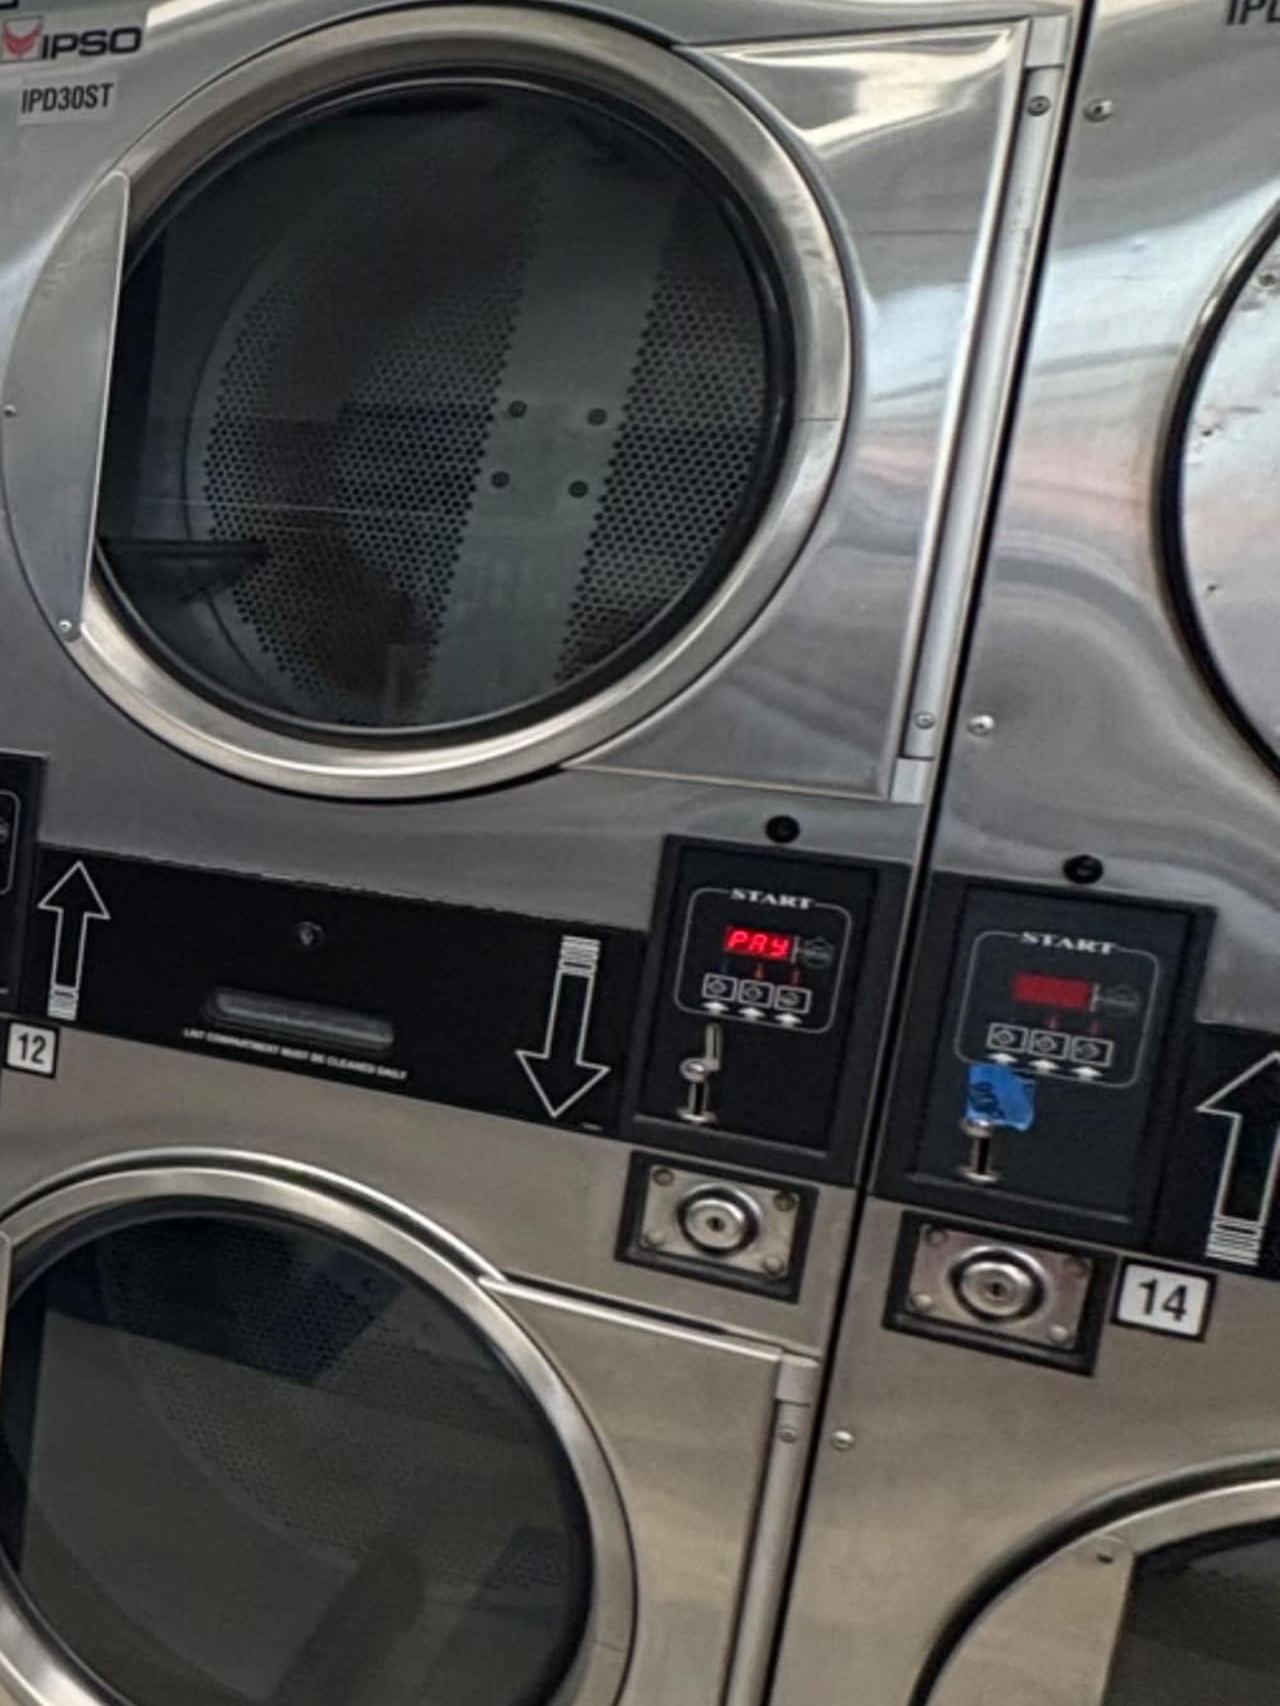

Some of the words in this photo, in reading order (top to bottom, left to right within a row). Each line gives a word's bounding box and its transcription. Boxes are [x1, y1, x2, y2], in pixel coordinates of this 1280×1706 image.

[42, 27, 143, 60] IPSO
[21, 83, 113, 114] IPD30ST
[730, 888, 814, 910] START
[1020, 931, 1117, 955] START
[18, 1033, 46, 1064] 12
[1138, 1278, 1187, 1322] 14
